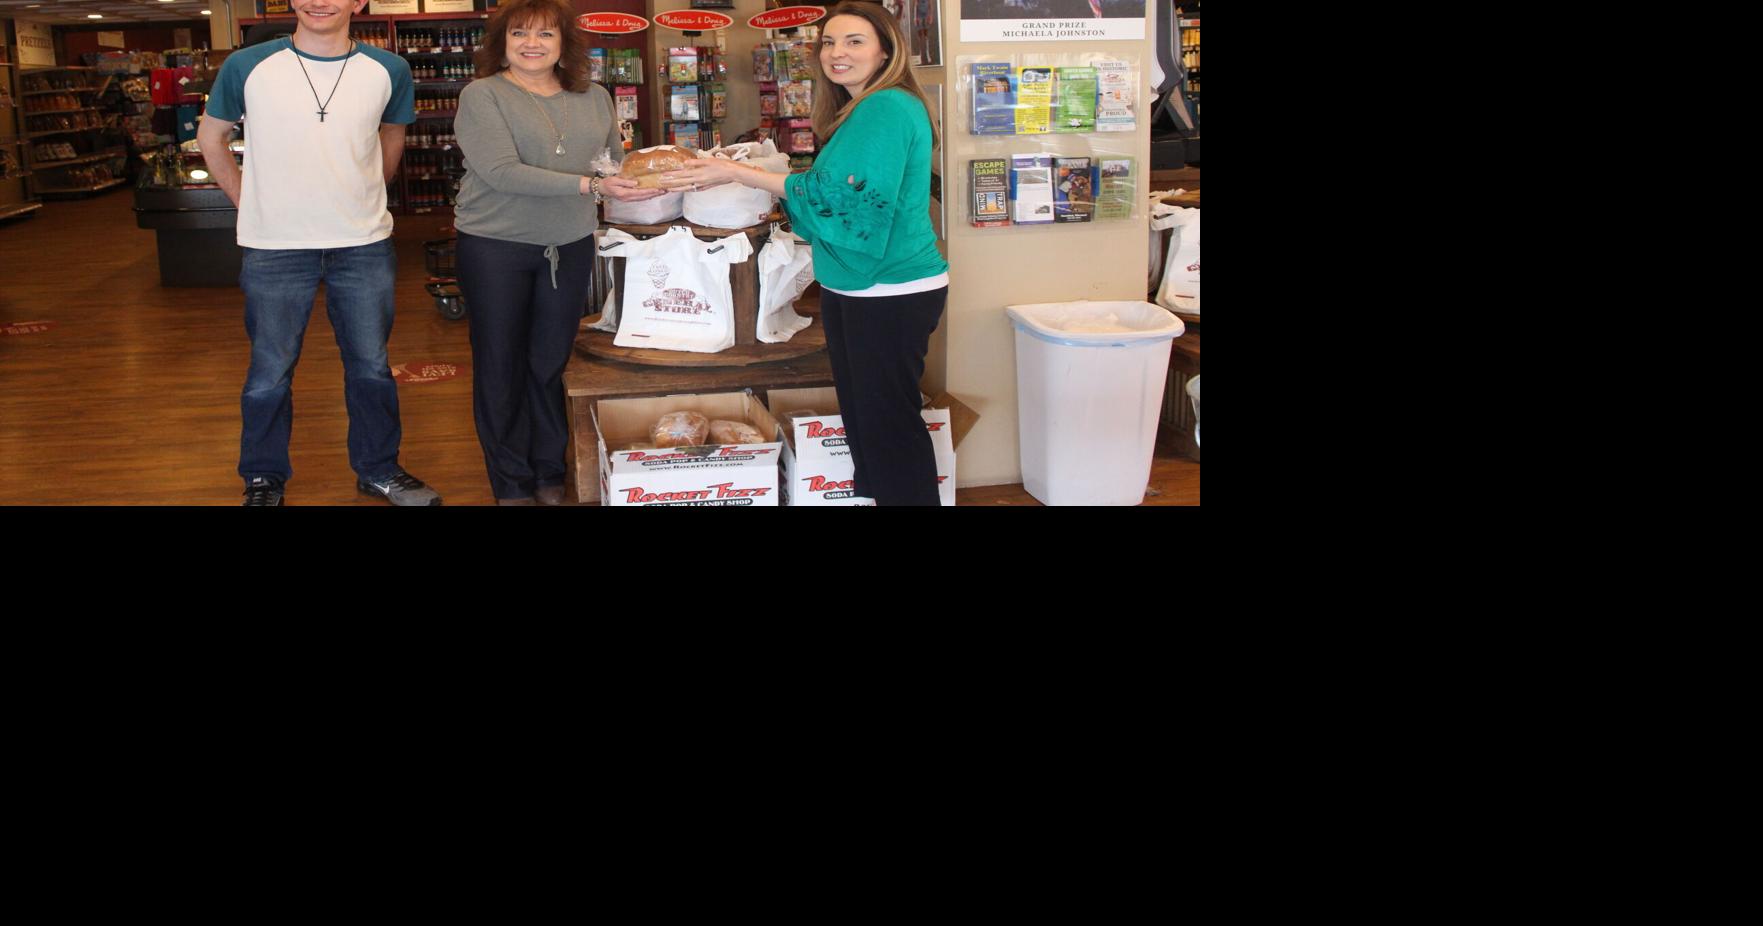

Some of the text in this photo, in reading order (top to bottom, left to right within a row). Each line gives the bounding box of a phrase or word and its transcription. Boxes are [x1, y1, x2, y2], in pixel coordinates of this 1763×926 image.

[580, 17, 614, 28] Melissa
[622, 19, 641, 30] Doug
[662, 15, 694, 25] Melissa
[704, 17, 726, 27] Doug
[755, 16, 789, 26] Melissa
[798, 11, 820, 21] Doug
[1056, 29, 1105, 37] JOHNSTON
[974, 161, 1006, 169] ESCAPE
[654, 304, 701, 315] STORE
[618, 482, 772, 504] ROCKET FIZZ
